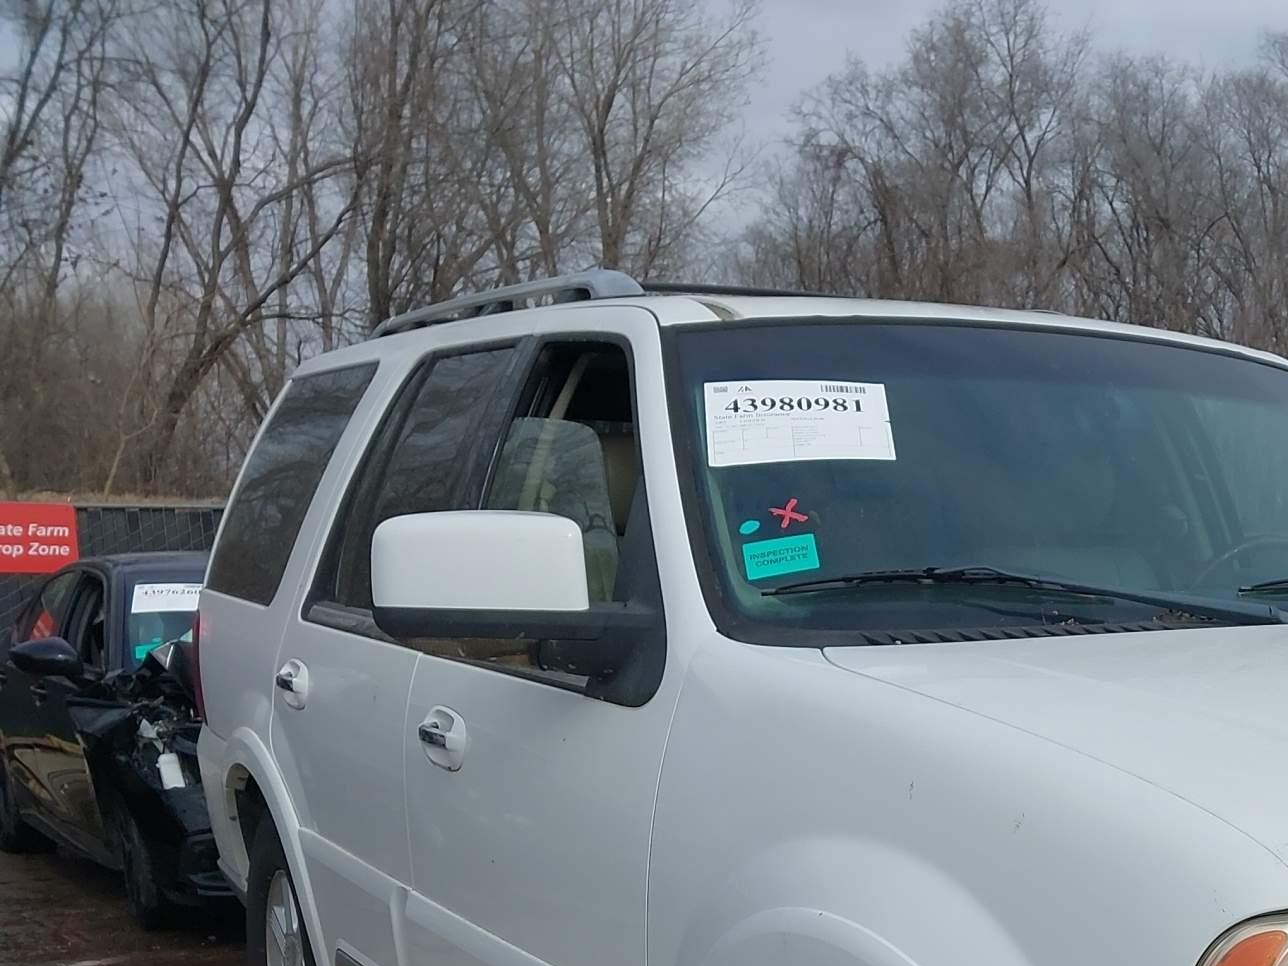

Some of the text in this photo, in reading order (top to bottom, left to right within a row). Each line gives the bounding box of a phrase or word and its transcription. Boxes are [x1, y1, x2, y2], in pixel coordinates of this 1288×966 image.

[725, 397, 863, 413] 43980981
[28, 523, 69, 537] Farm
[0, 542, 70, 558] op Zone
[749, 544, 809, 561] INSPECTION
[755, 553, 809, 568] COMPLETE
